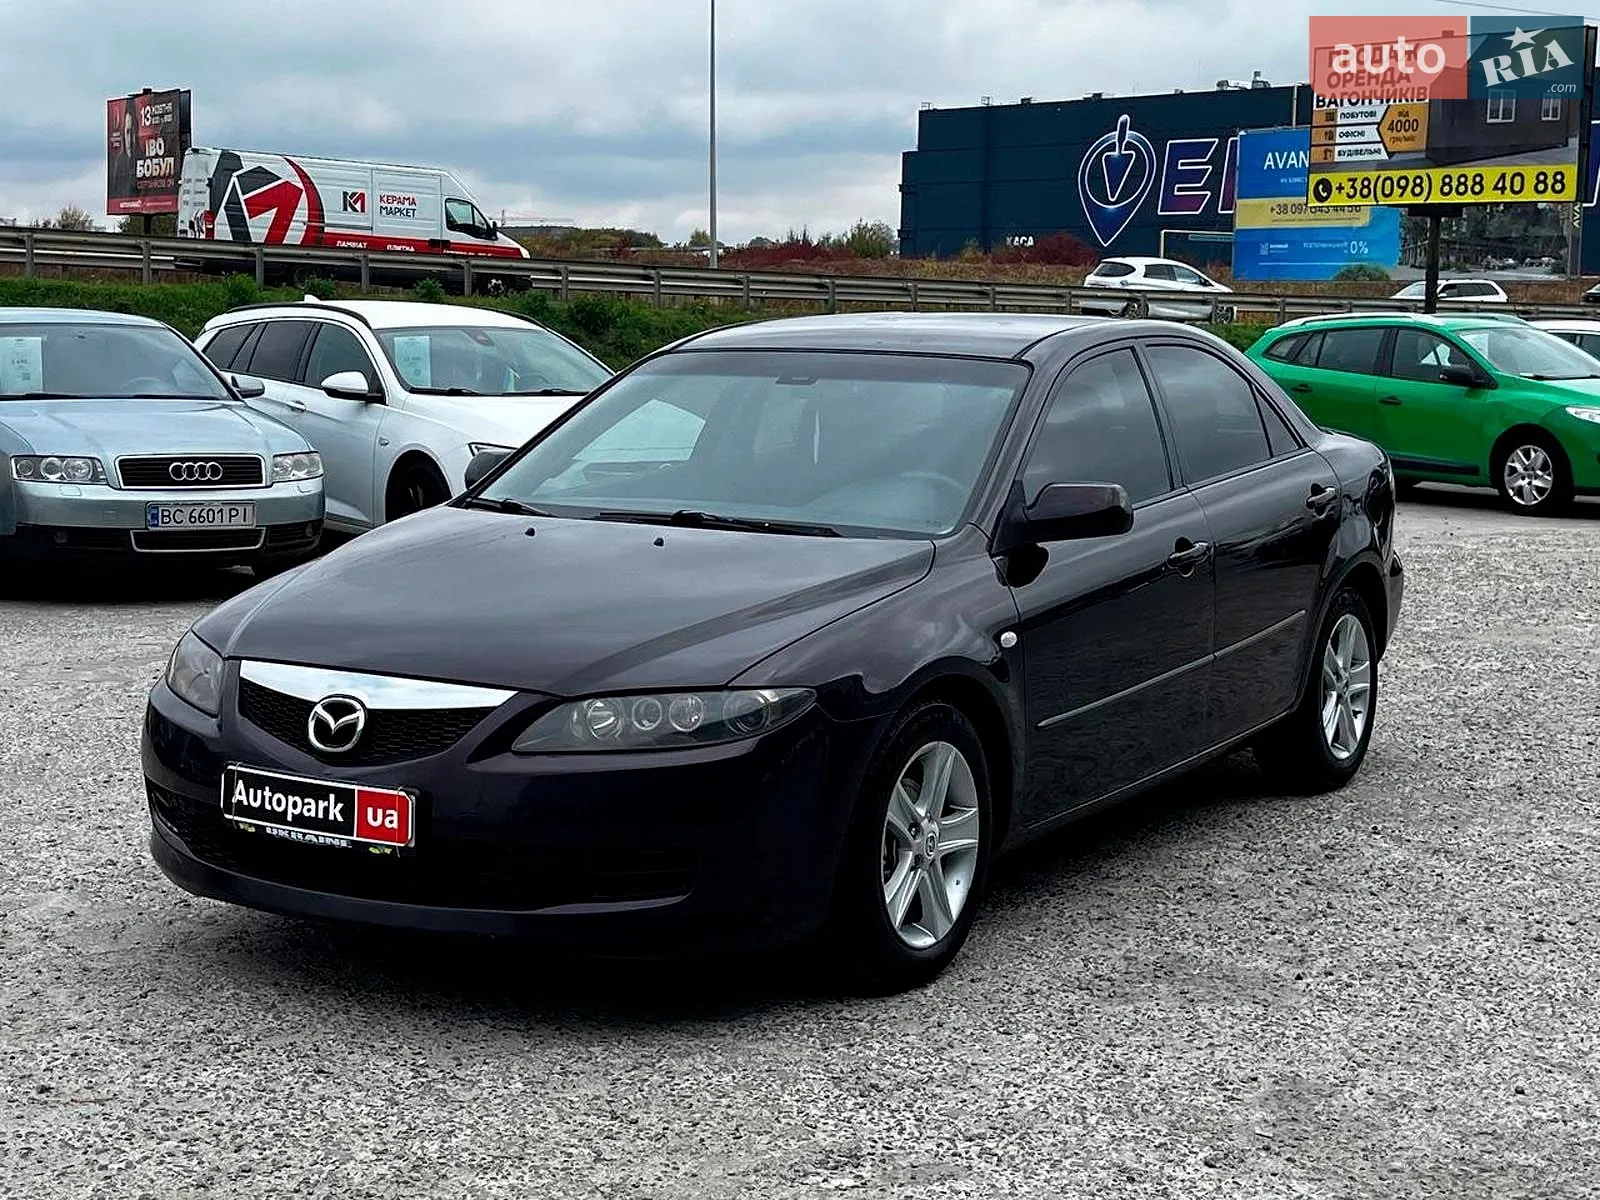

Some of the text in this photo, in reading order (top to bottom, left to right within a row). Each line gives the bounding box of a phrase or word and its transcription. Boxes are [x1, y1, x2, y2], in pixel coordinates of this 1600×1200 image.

[1326, 67, 1412, 89] ОРЕНДА
[1315, 87, 1428, 108] ВАГОНЧИКІВ
[141, 105, 151, 127] 13
[1340, 110, 1377, 119] ПОБУТОВІ
[1388, 119, 1419, 132] 4000
[1338, 130, 1365, 138] ОФІСНІ
[146, 138, 164, 157] ІВО
[1337, 147, 1381, 157] БУДІВЕЛЬНІ
[136, 157, 175, 178] БОБУЛ
[1335, 170, 1566, 203] +38(098) 888 40 88
[380, 194, 416, 207] КЕРАМА
[380, 205, 416, 217] МАРКЕТ
[1270, 203, 1289, 215] +38
[1006, 235, 1034, 247] КАСА
[1350, 241, 1368, 254] 0%
[161, 507, 247, 524] BC 6601 PI
[233, 779, 399, 829] Autopark ua
